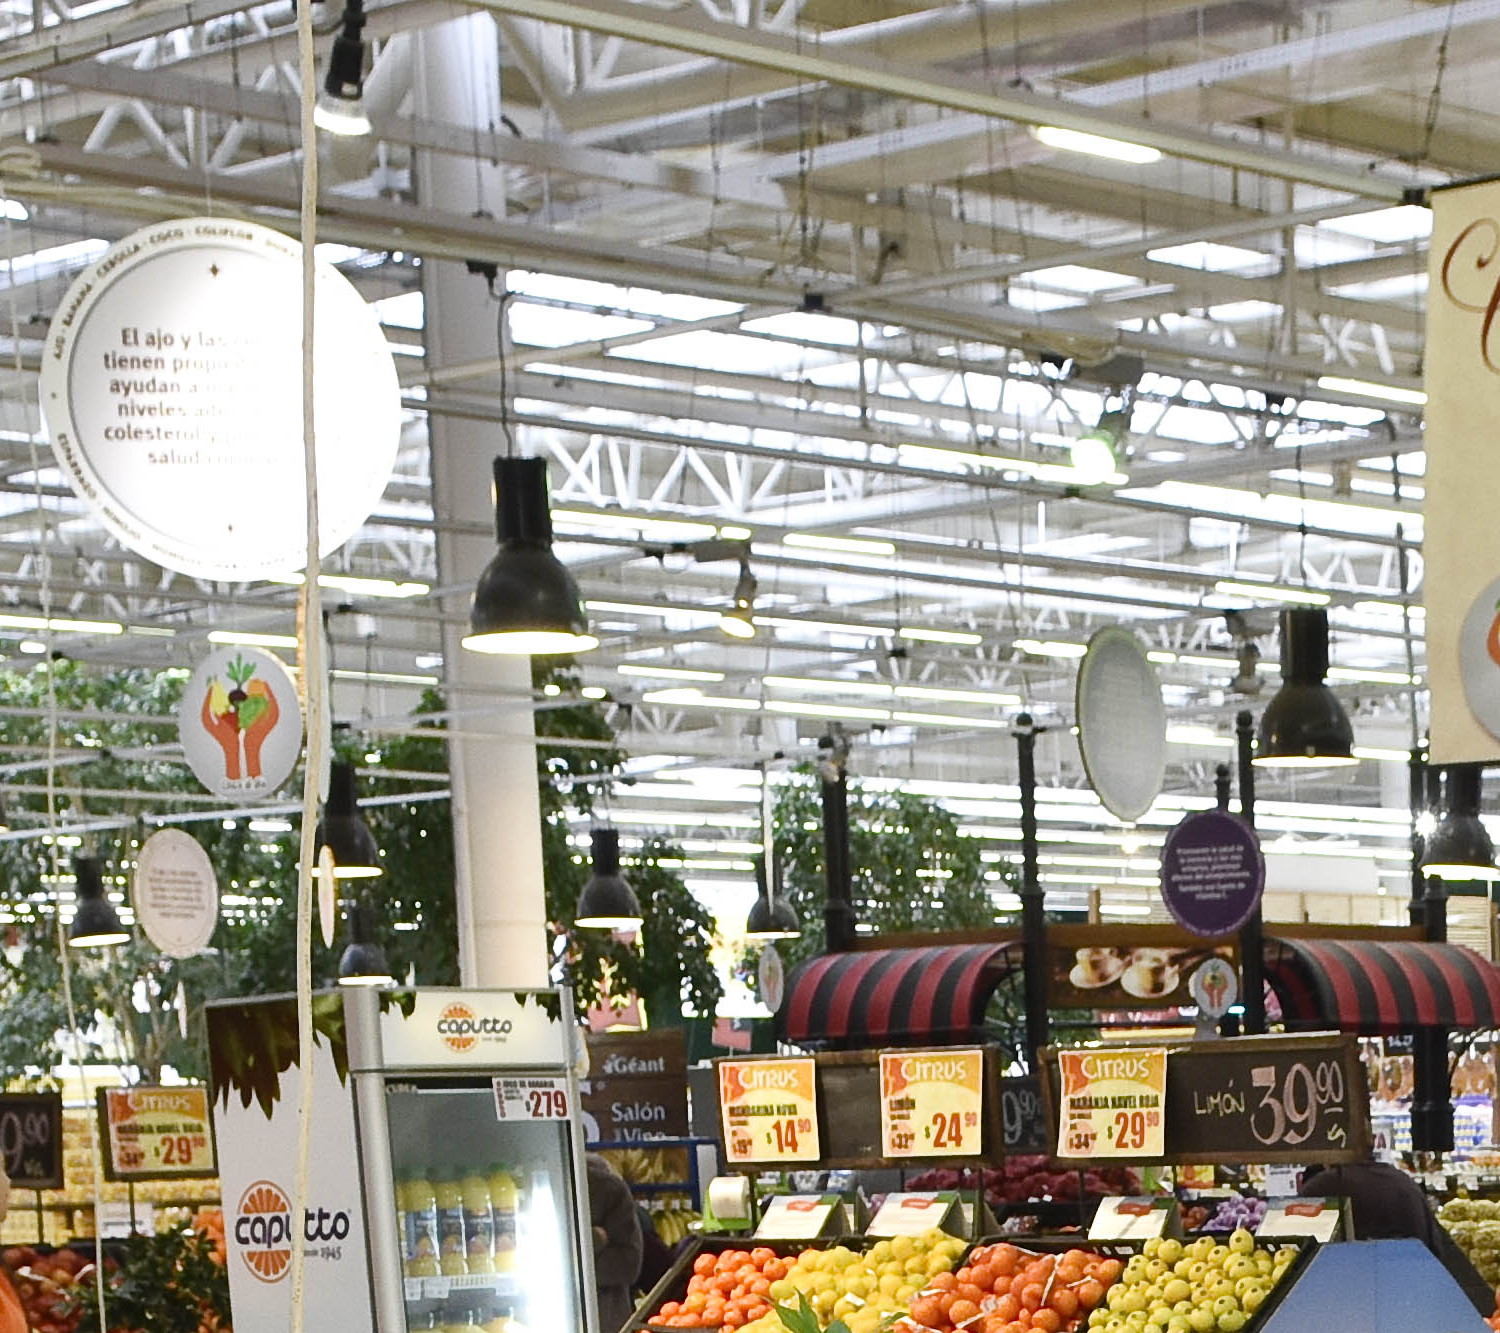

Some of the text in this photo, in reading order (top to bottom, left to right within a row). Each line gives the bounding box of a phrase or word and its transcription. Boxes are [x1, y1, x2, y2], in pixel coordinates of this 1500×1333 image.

[121, 328, 191, 351] El ajo y
[103, 352, 165, 370] tienen
[109, 376, 181, 398] ayudan
[437, 1016, 512, 1036] caputto
[614, 1055, 665, 1074] Géant
[611, 1101, 665, 1123] Salón
